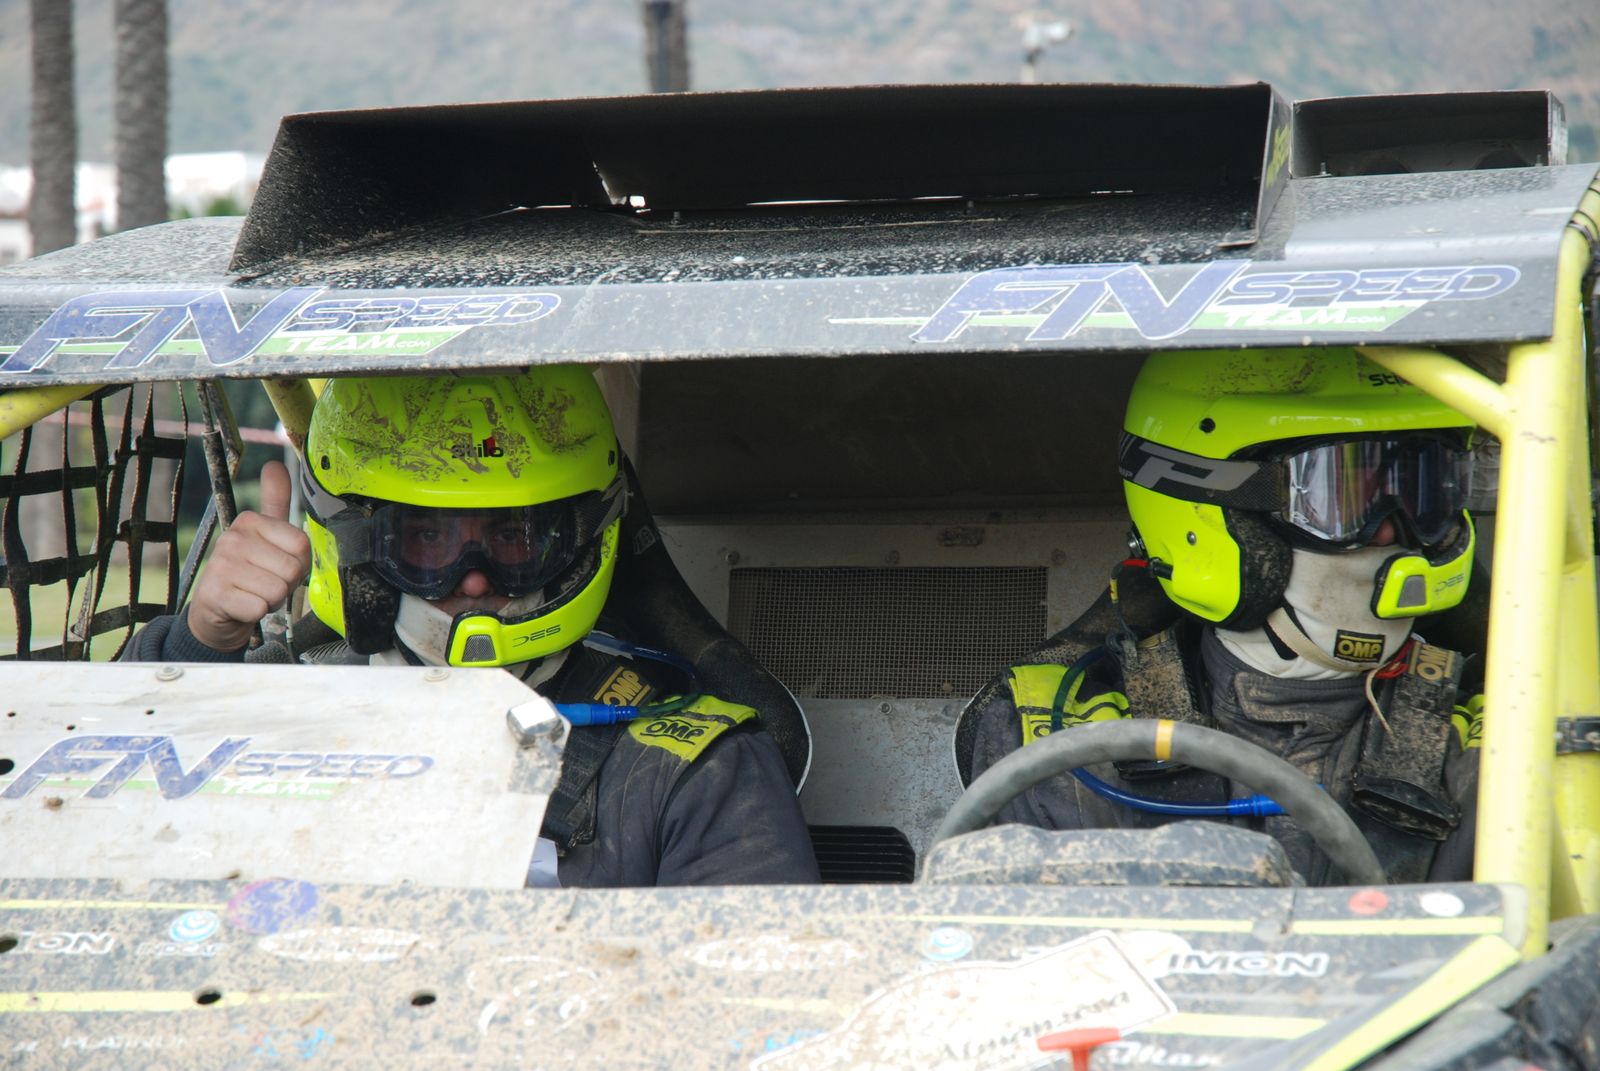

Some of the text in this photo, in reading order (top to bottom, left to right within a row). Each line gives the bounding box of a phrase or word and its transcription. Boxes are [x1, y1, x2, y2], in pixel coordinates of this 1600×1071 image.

[1337, 639, 1382, 659] OMP
[602, 669, 641, 707] OMP
[645, 720, 705, 740] OMP
